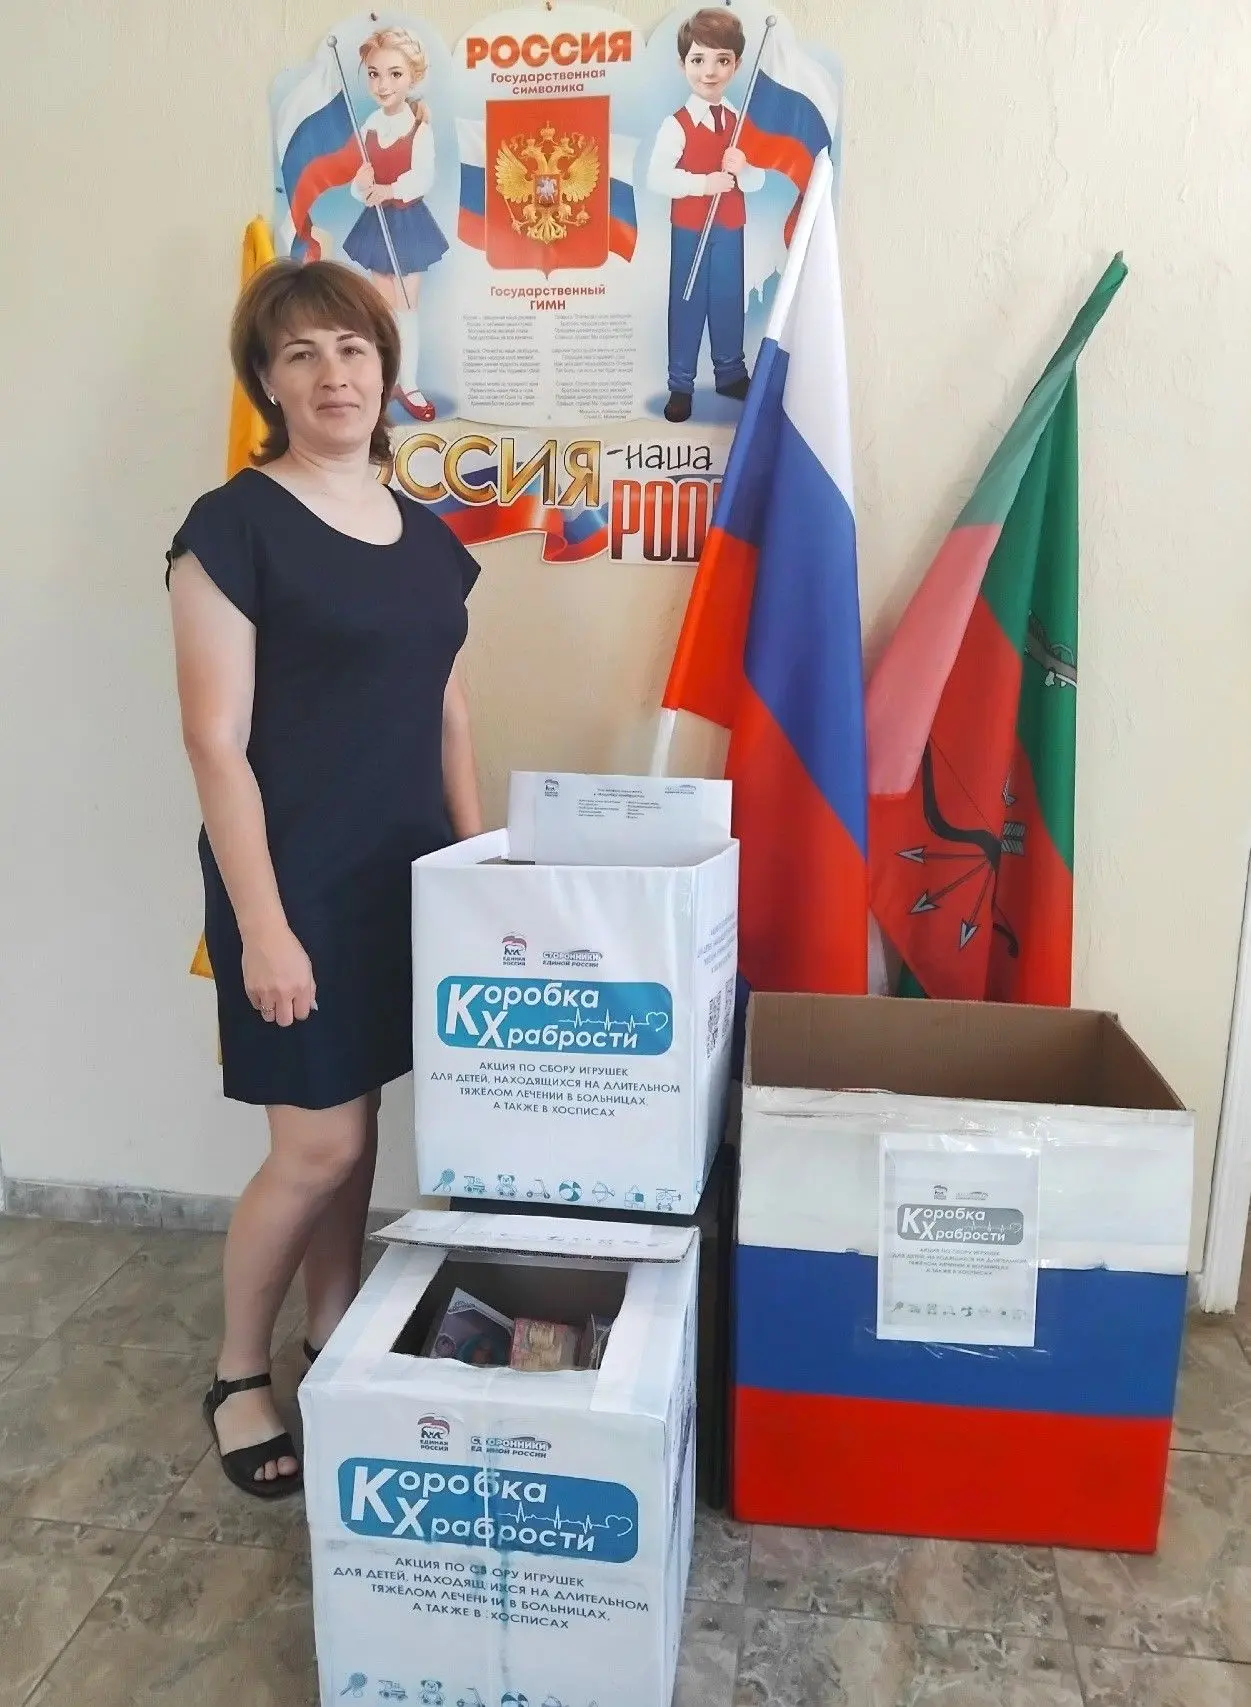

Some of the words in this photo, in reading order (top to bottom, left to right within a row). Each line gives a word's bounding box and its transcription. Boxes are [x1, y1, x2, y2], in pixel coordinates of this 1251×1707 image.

[466, 31, 632, 69] РОССИЯ
[491, 69, 606, 83] Государственная
[512, 83, 584, 95] символика
[490, 284, 606, 298] Государственный
[611, 480, 721, 562] РОД
[445, 982, 600, 1036] Коробка
[477, 1010, 639, 1051] Храбрости
[479, 1061, 516, 1072] АКЦИЯ
[519, 1063, 536, 1072] ПО
[539, 1063, 576, 1074] СБОРУ
[579, 1065, 629, 1077] ИГРУШЕК
[430, 1072, 453, 1082] ДЛЯ
[455, 1073, 491, 1084] ДЕТЕЙ,
[493, 1075, 581, 1089] НАХОДЯЩИХСЯ
[584, 1080, 600, 1089] НА
[603, 1081, 681, 1093] ДЛИТЕЛЬНОМ
[515, 1089, 564, 1101] ЛЕЧЕНИИ
[566, 1093, 573, 1101] В
[493, 1101, 501, 1109] А
[503, 1102, 539, 1112] ТАКЖЕ
[542, 1104, 548, 1112] В
[552, 1105, 615, 1117] ХОСПИСАХ
[901, 1207, 985, 1233] Коробка
[919, 1221, 1006, 1242] Храбрости
[512, 1450, 547, 1458] РОССИИ
[351, 1466, 548, 1524] Коробка
[391, 1496, 596, 1552] Храбрости
[395, 1557, 440, 1570] АКЦИЯ
[444, 1562, 465, 1572] ПО
[523, 1571, 585, 1588] ИГРУШЕК
[333, 1567, 362, 1577] ДЛЯ
[530, 1587, 549, 1598] НА
[553, 1590, 649, 1612] ДЛИТЕЛЬНОМ
[412, 1602, 422, 1612] А
[425, 1603, 470, 1617] ТАКЖЕ
[473, 1608, 482, 1618] В
[490, 1611, 570, 1629] ХОСПИСАХ
[509, 1599, 517, 1609] В
